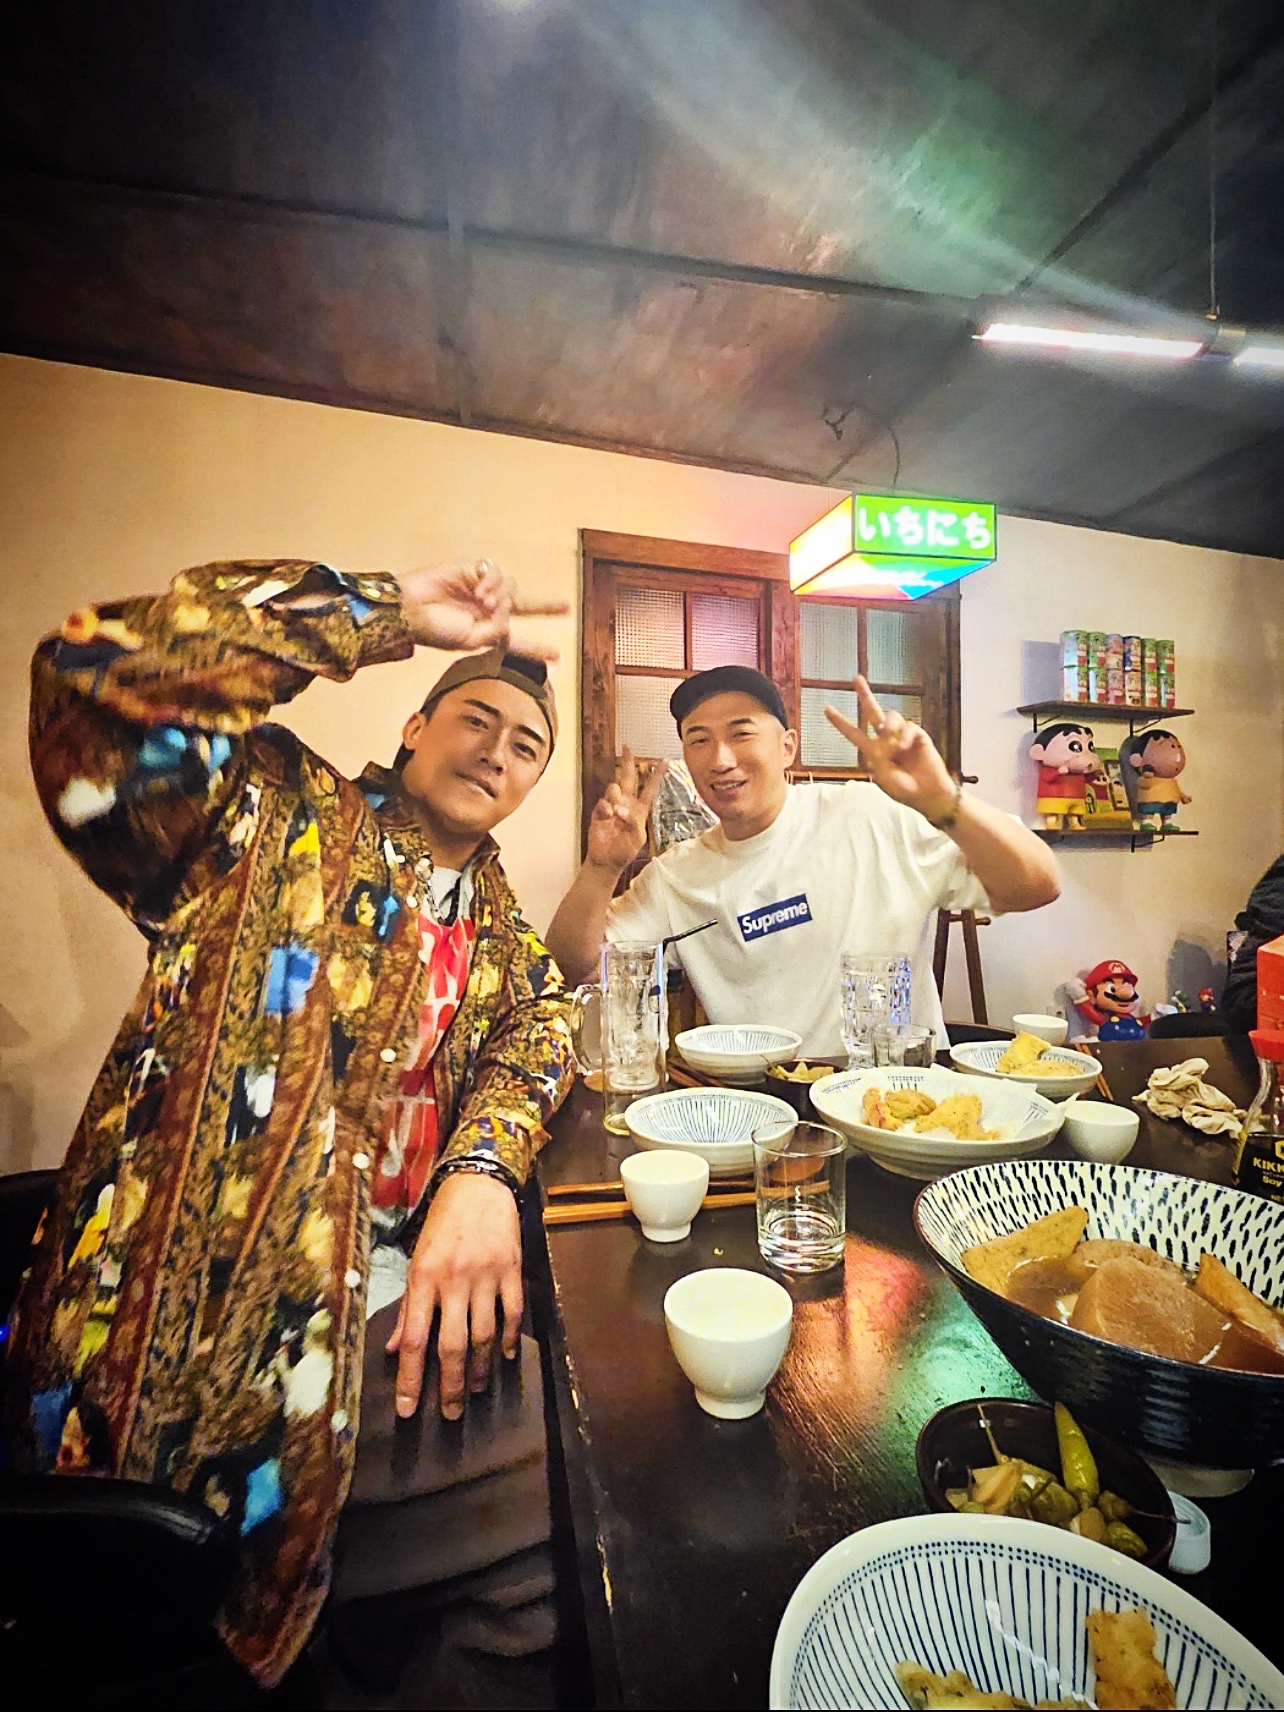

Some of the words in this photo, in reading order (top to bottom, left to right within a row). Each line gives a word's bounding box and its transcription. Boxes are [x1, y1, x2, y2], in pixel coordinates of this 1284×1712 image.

[858, 506, 991, 549] いちにち
[742, 902, 808, 933] Supreme
[1263, 1175, 1282, 1187] Soy
